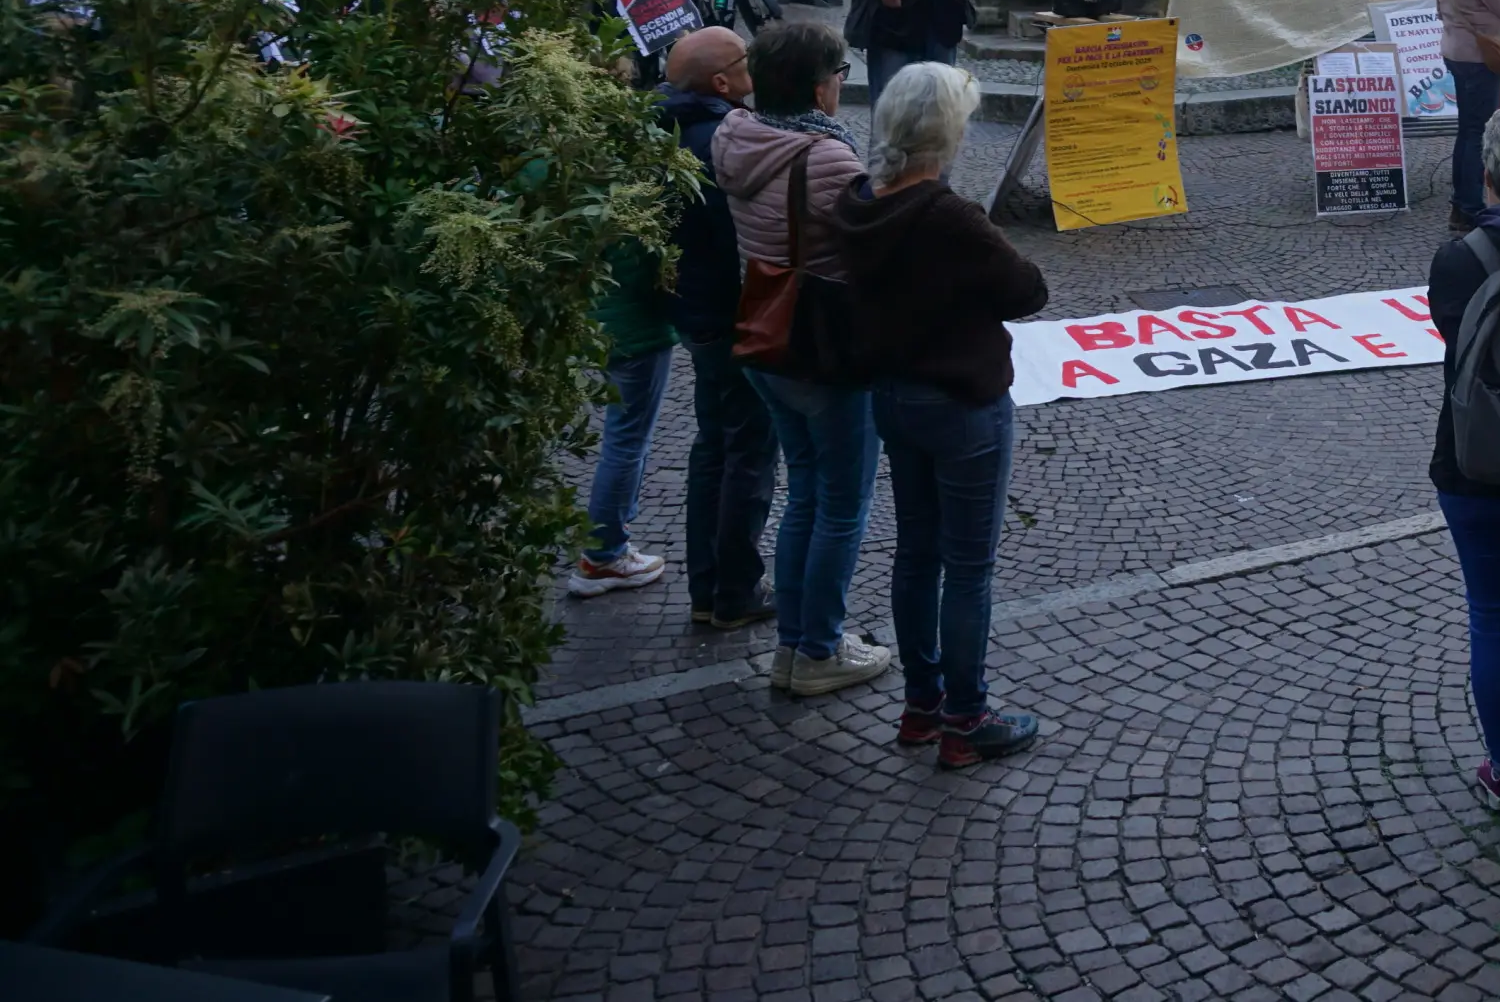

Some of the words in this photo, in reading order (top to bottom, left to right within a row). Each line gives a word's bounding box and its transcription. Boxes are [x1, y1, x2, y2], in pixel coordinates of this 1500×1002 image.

[639, 10, 677, 34] SCENDI
[677, 7, 685, 16] IN
[643, 19, 680, 43] PIAZZA
[1408, 28, 1429, 36] NAVI
[1074, 56, 1084, 64] LA
[1065, 304, 1342, 352] BASTA
[1061, 359, 1121, 388] A
[1133, 338, 1351, 379] GAZA
[1350, 333, 1408, 359] E
